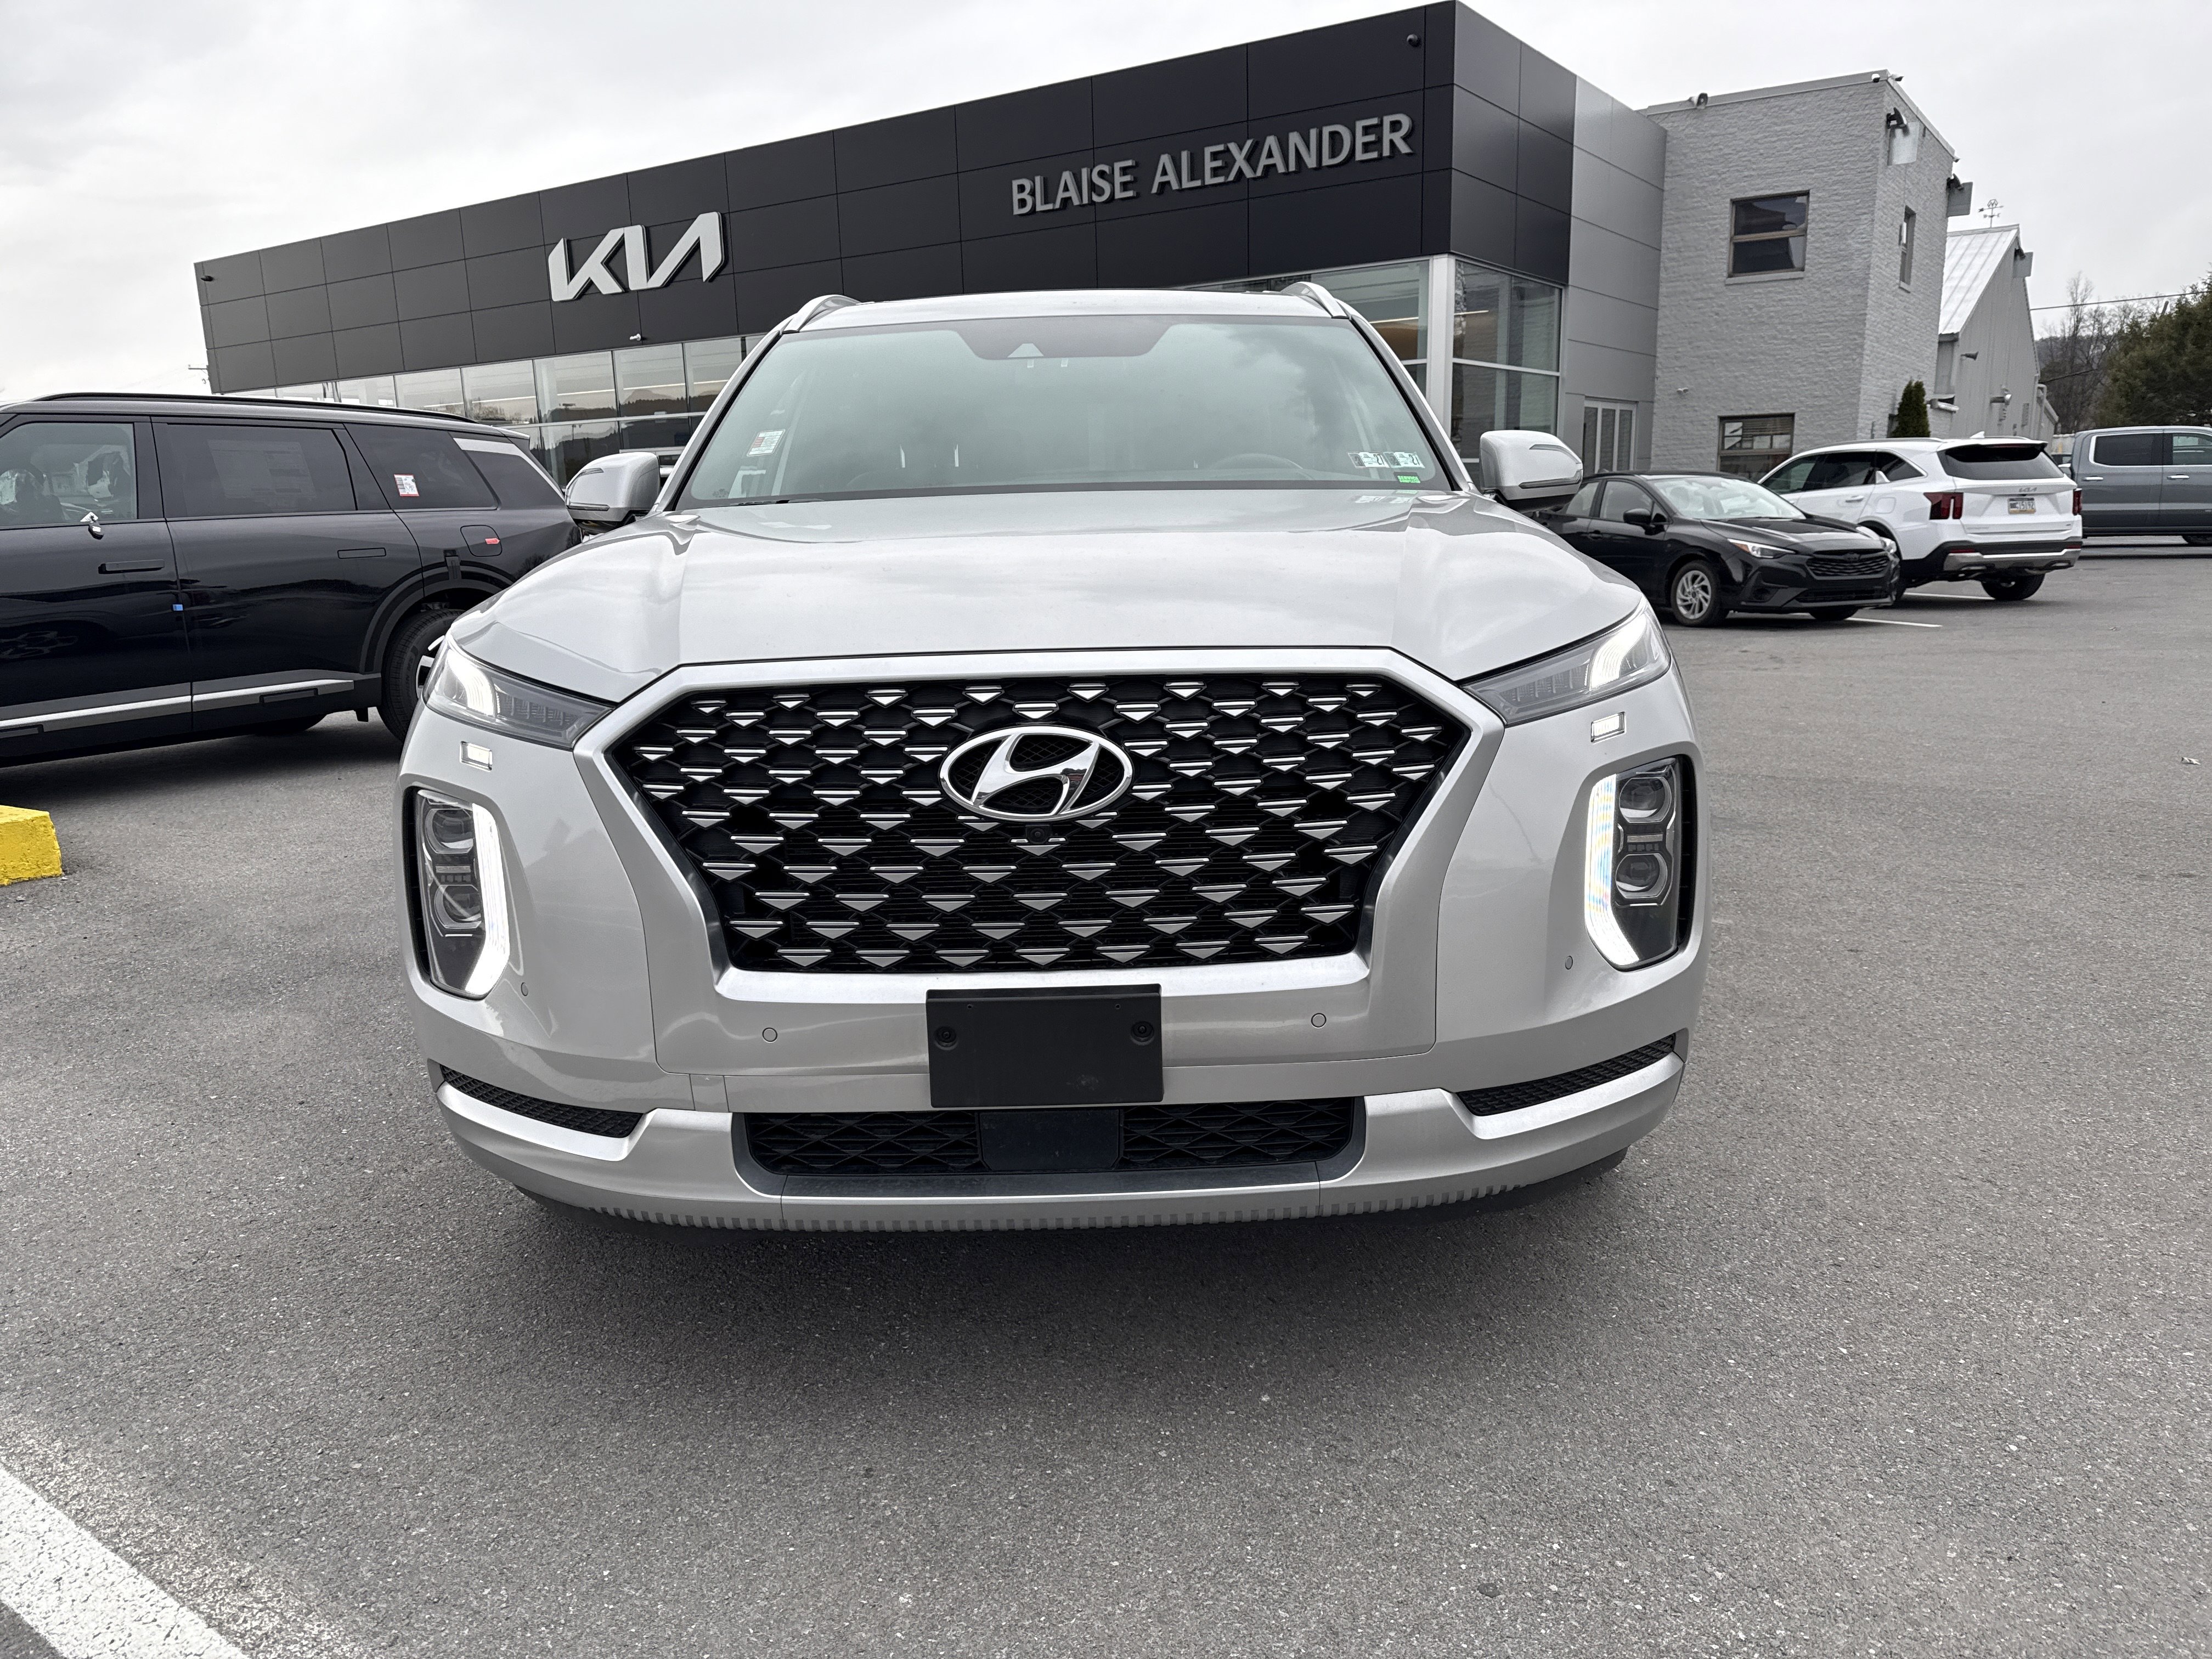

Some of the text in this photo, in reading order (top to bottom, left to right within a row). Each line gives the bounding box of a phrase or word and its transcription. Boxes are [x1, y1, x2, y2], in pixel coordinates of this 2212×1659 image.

[1012, 112, 1413, 215] BLAISE ALEXANDER
[548, 211, 724, 302] KIA
